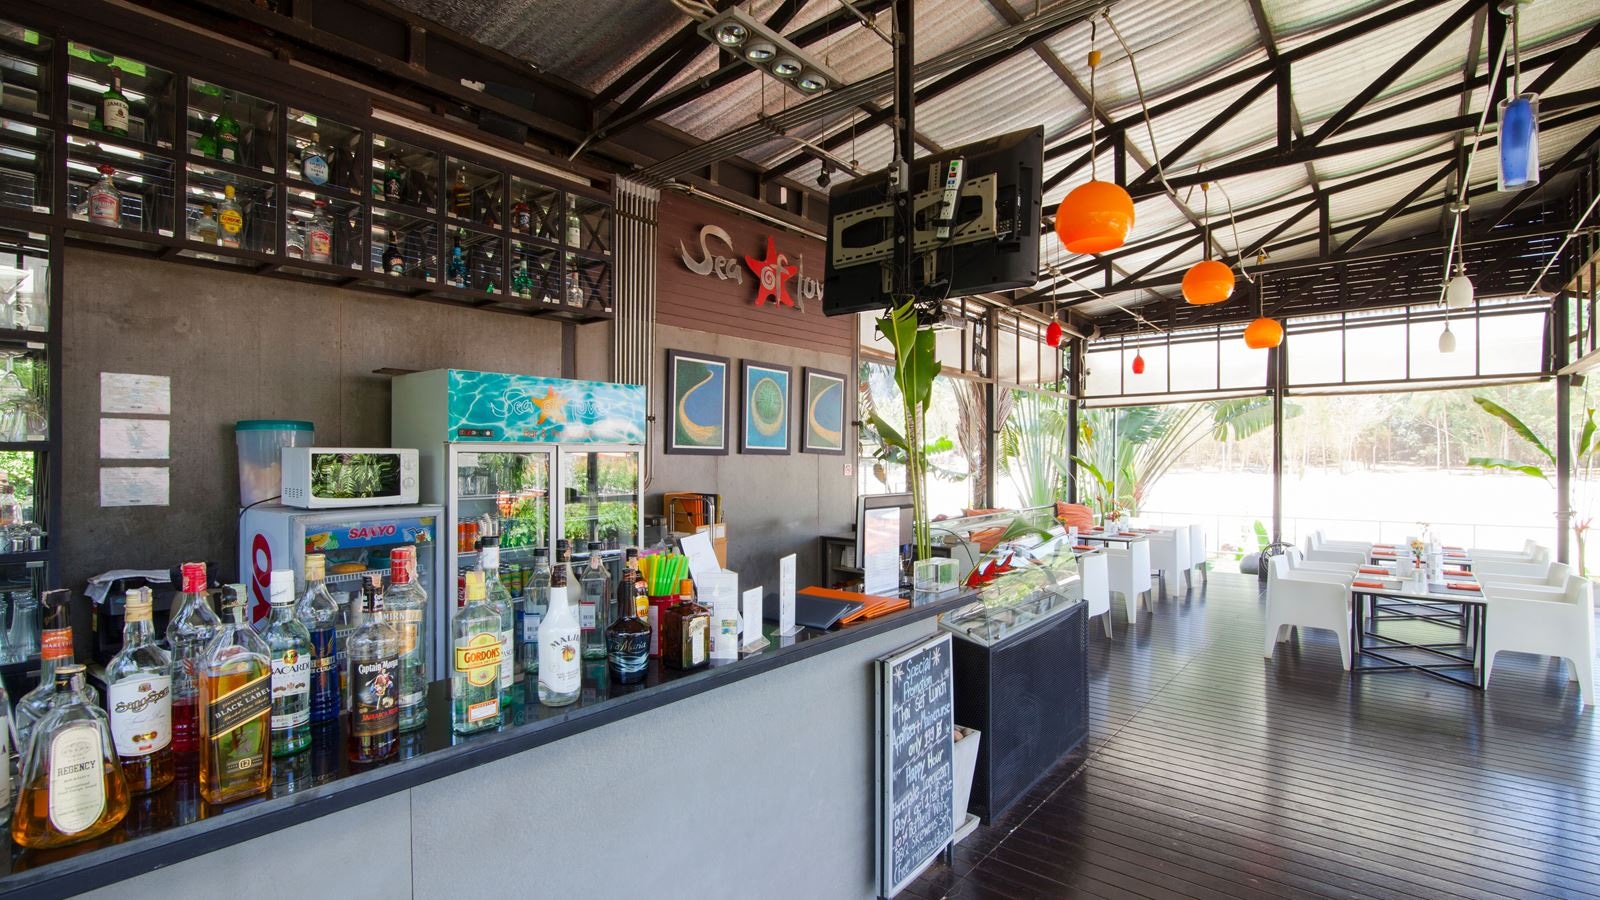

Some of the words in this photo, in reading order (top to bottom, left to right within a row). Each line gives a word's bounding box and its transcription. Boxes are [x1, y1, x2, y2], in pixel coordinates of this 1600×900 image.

[680, 225, 743, 285] Sea
[761, 254, 789, 304] of
[797, 253, 824, 313] lov
[490, 387, 534, 417] Sea
[349, 524, 396, 539] SANYO
[464, 648, 500, 663] GORDON'S
[358, 662, 382, 675] Captain
[906, 651, 931, 685] Special
[904, 675, 932, 700] Promotion
[929, 681, 947, 703] Lunch
[215, 700, 243, 719] BLACK
[245, 687, 271, 703] LABEL
[57, 760, 96, 777] REGENCY
